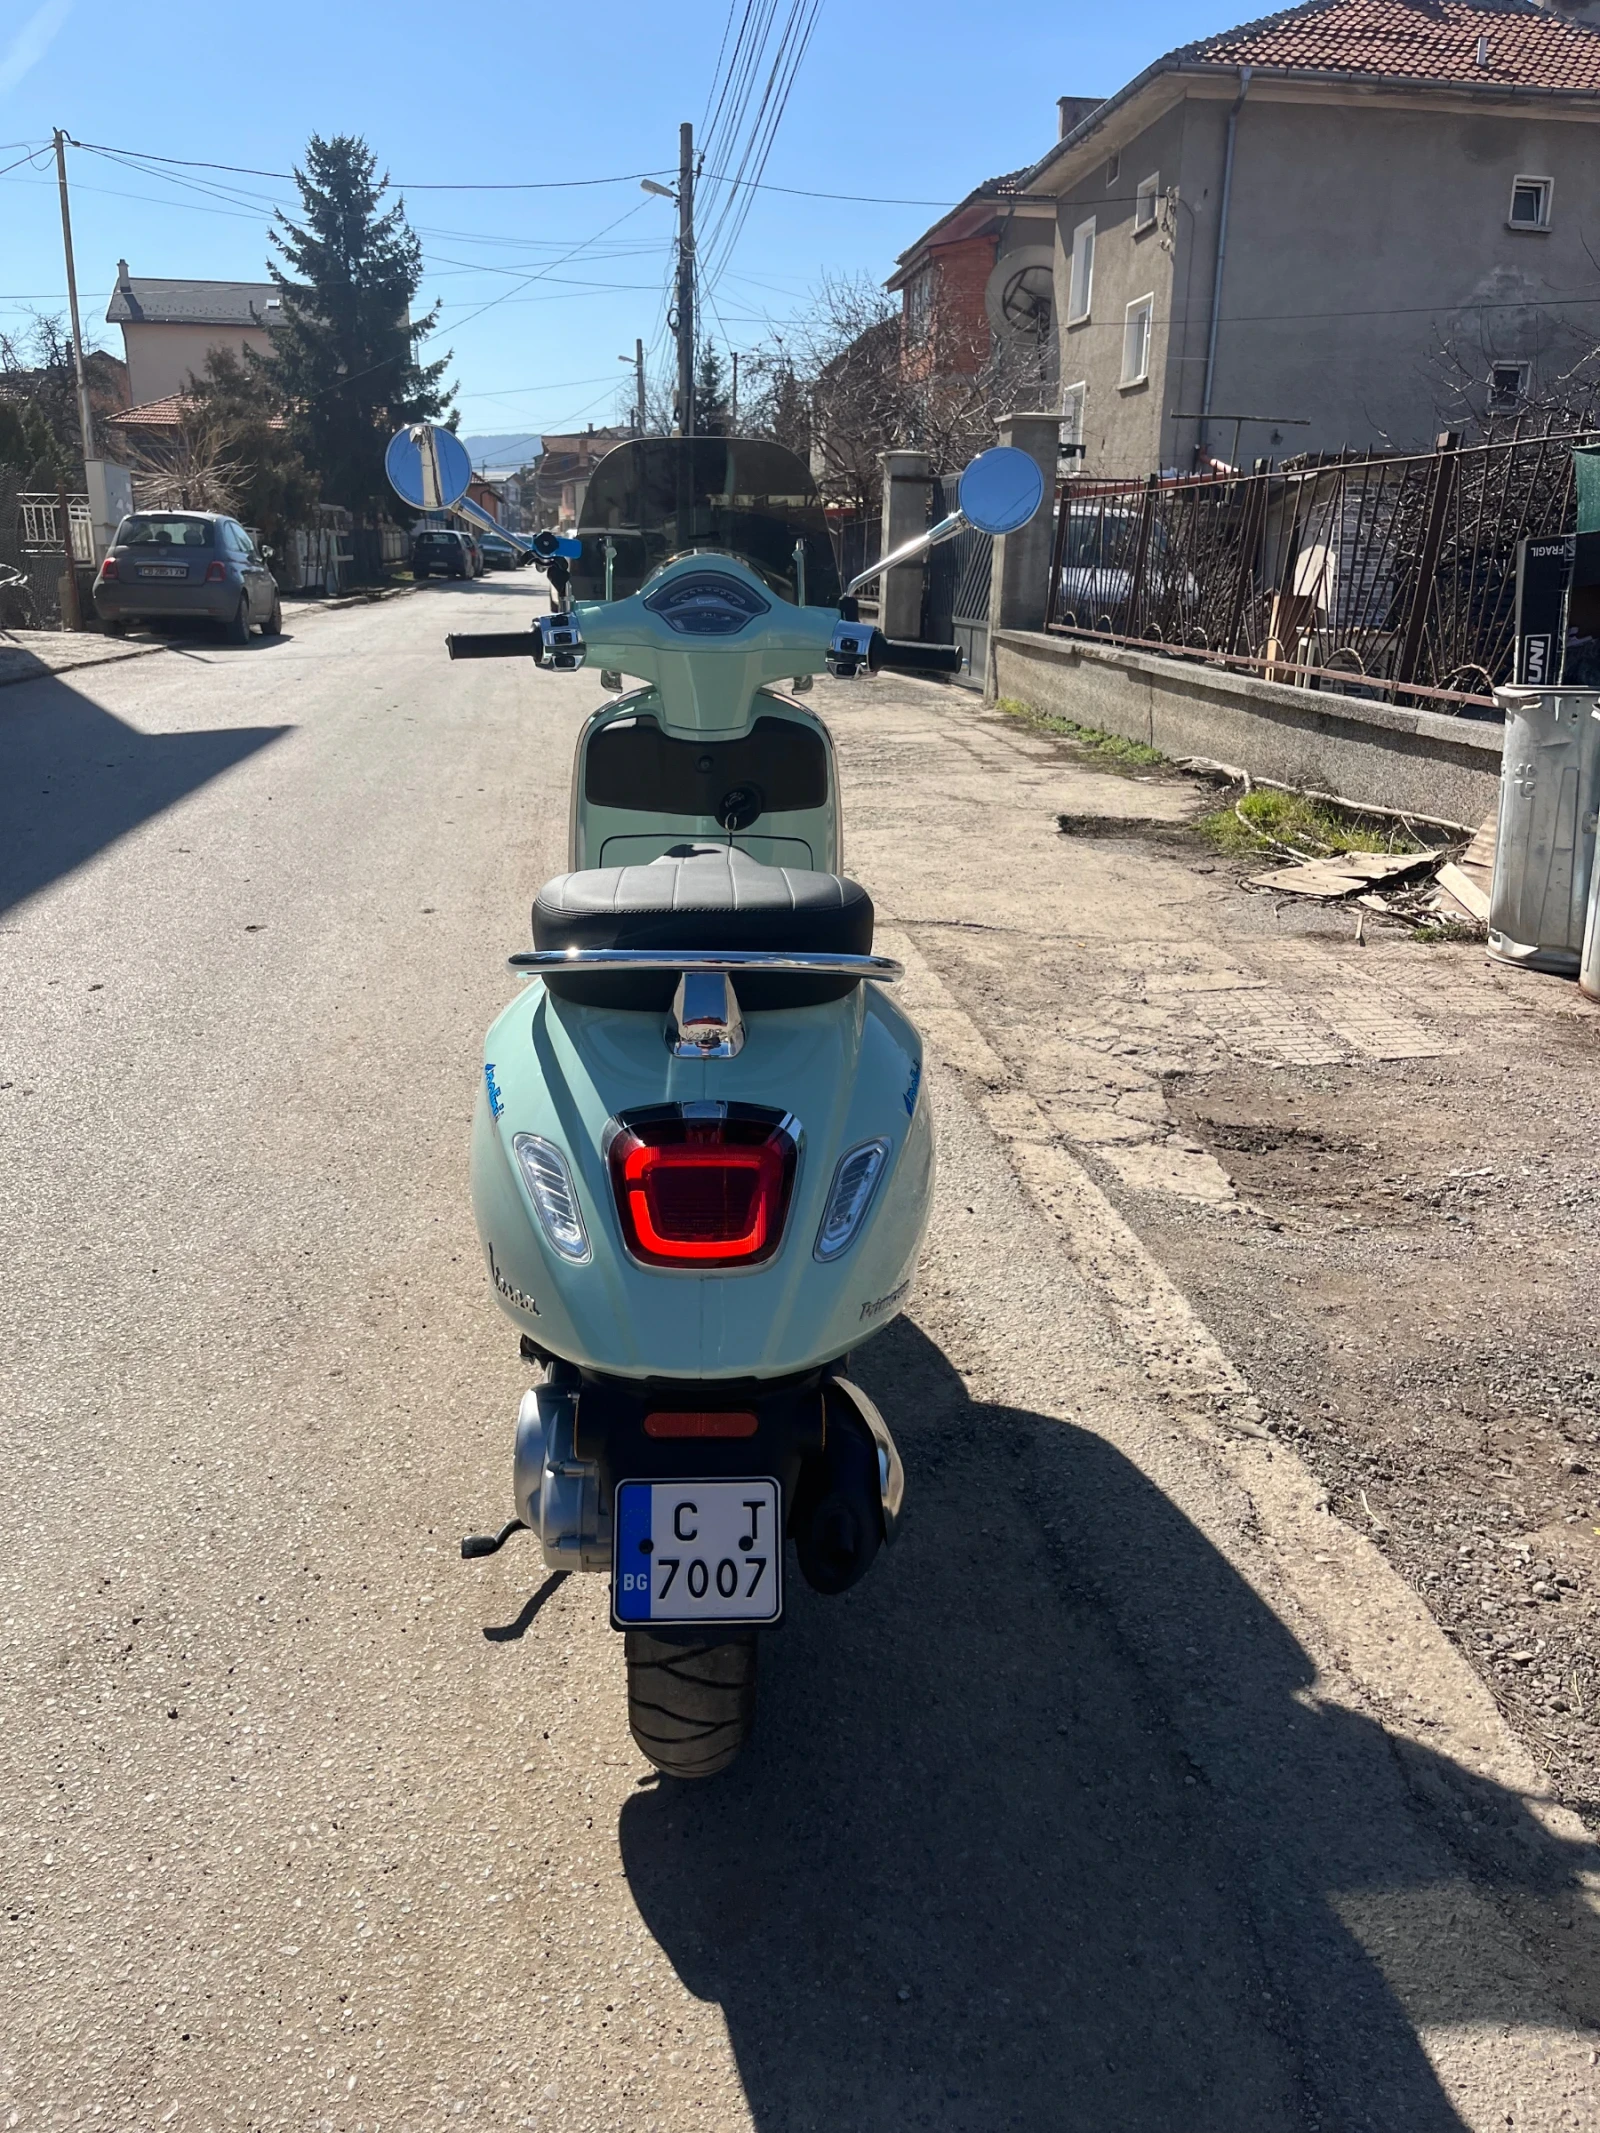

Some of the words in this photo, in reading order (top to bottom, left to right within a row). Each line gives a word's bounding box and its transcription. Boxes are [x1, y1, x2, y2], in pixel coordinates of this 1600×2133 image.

[1530, 545, 1564, 557] FRAGIL
[1528, 640, 1545, 685] UNI
[674, 1502, 698, 1542] C
[742, 1501, 766, 1540] T
[623, 1573, 648, 1591] BG
[657, 1558, 767, 1600] 7007
